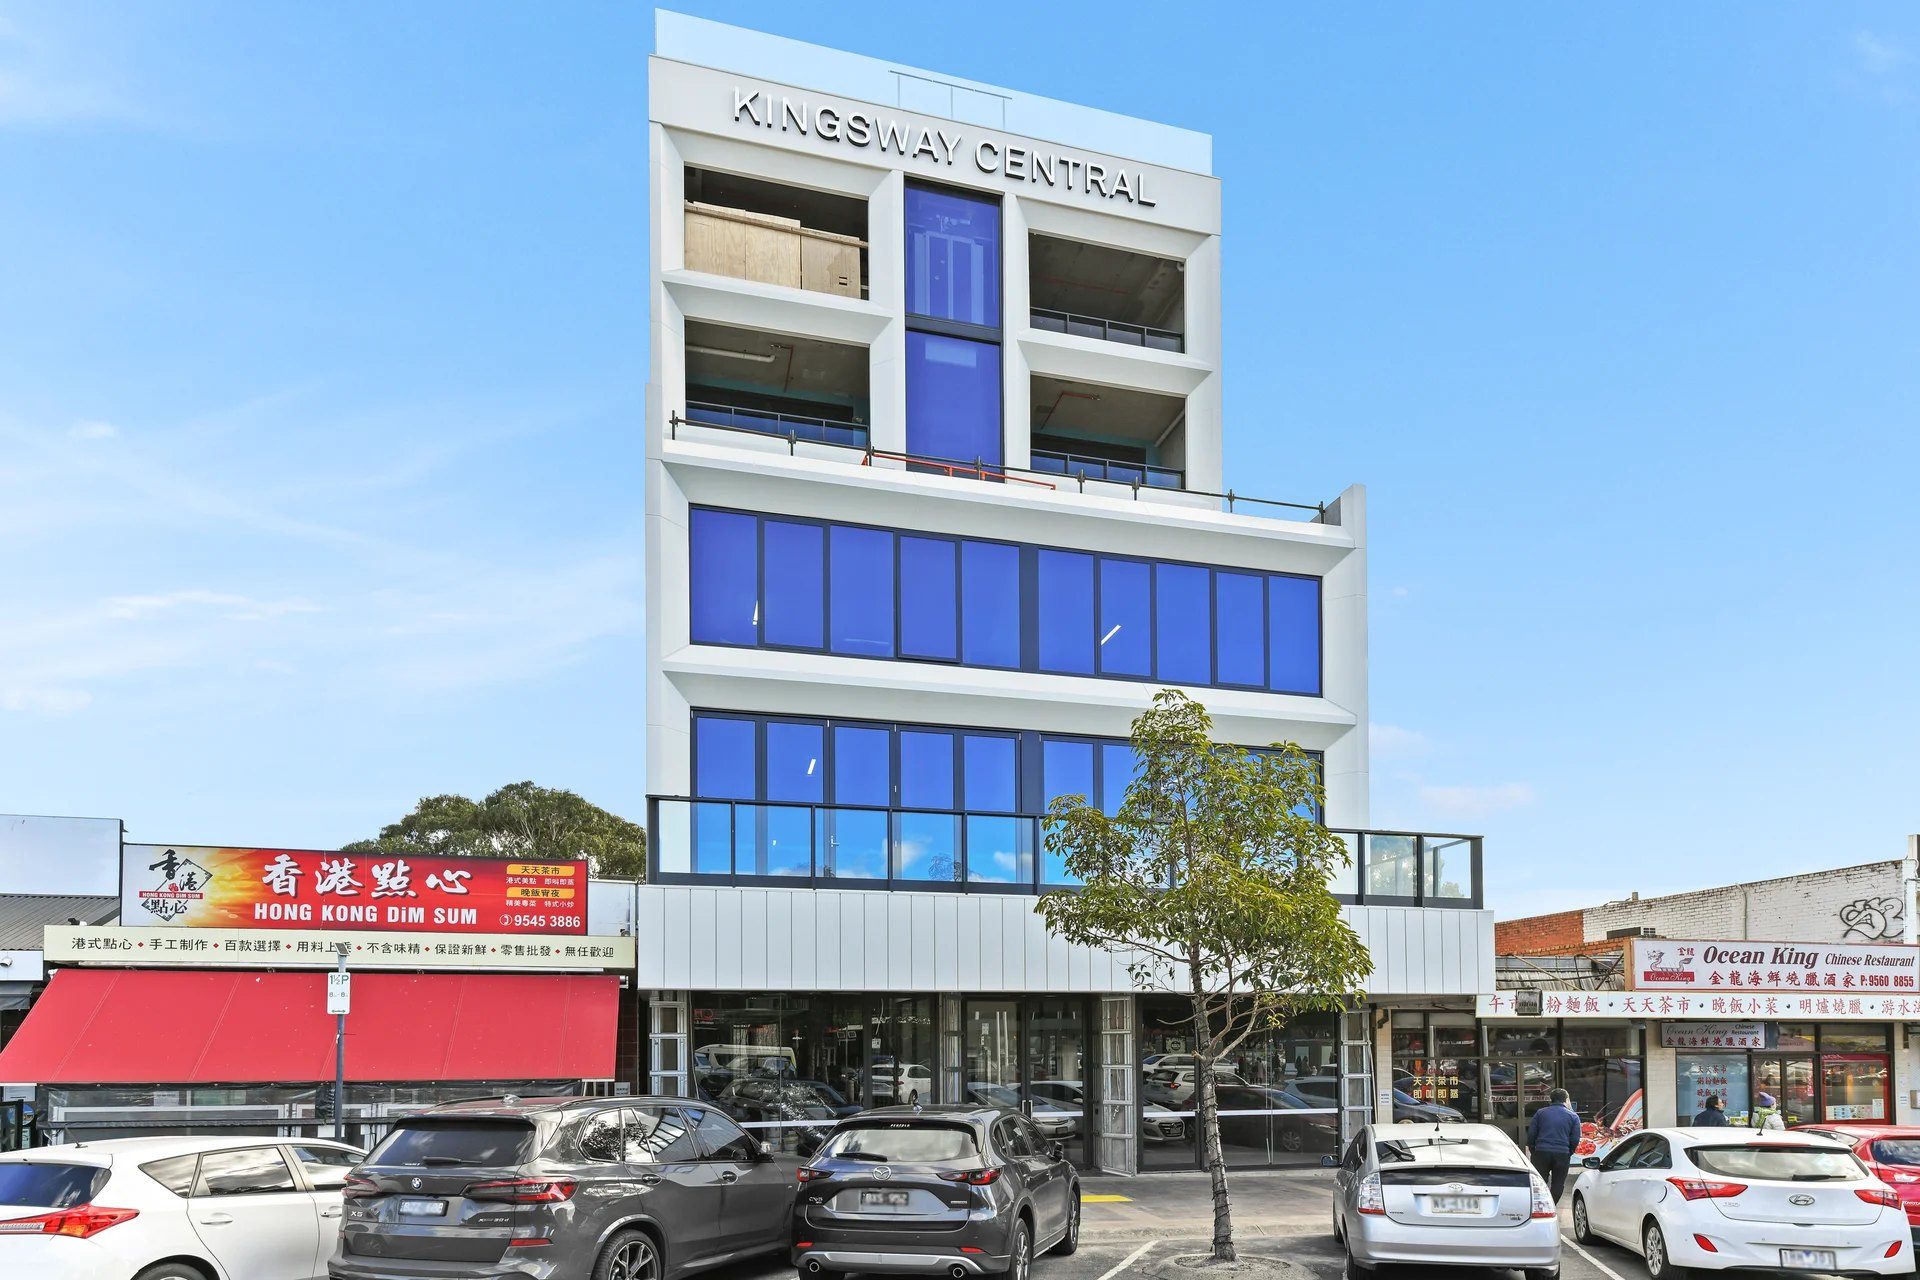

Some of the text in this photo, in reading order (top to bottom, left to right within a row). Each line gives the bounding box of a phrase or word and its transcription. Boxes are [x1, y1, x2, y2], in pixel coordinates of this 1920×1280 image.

[734, 86, 1157, 206] KINGSWAY CENTRAL
[262, 853, 472, 898] 香港點心
[521, 865, 560, 875] 天天茶市
[254, 903, 312, 921] HONG
[321, 904, 378, 922] KONG
[433, 907, 477, 925] SUM
[514, 914, 581, 928] 9545 3886
[71, 937, 133, 950] 港式點心
[149, 938, 208, 951] 手工制作
[224, 939, 281, 952] 百款選擇
[366, 942, 420, 954] 不含味精
[434, 943, 487, 955] 保證新鮮
[500, 944, 551, 956] 零售批發
[564, 945, 615, 958] 無任歡迎
[1703, 945, 1915, 969] Ocean King Chinese Restaurant
[1649, 972, 1669, 981] Ocean
[1893, 975, 1914, 988] 8855
[1621, 995, 1691, 1015] 天天茶市
[1712, 997, 1779, 1016] 晚飯小菜
[1666, 1023, 1728, 1038] Ocean King
[1413, 1076, 1459, 1086] 天天茶市
